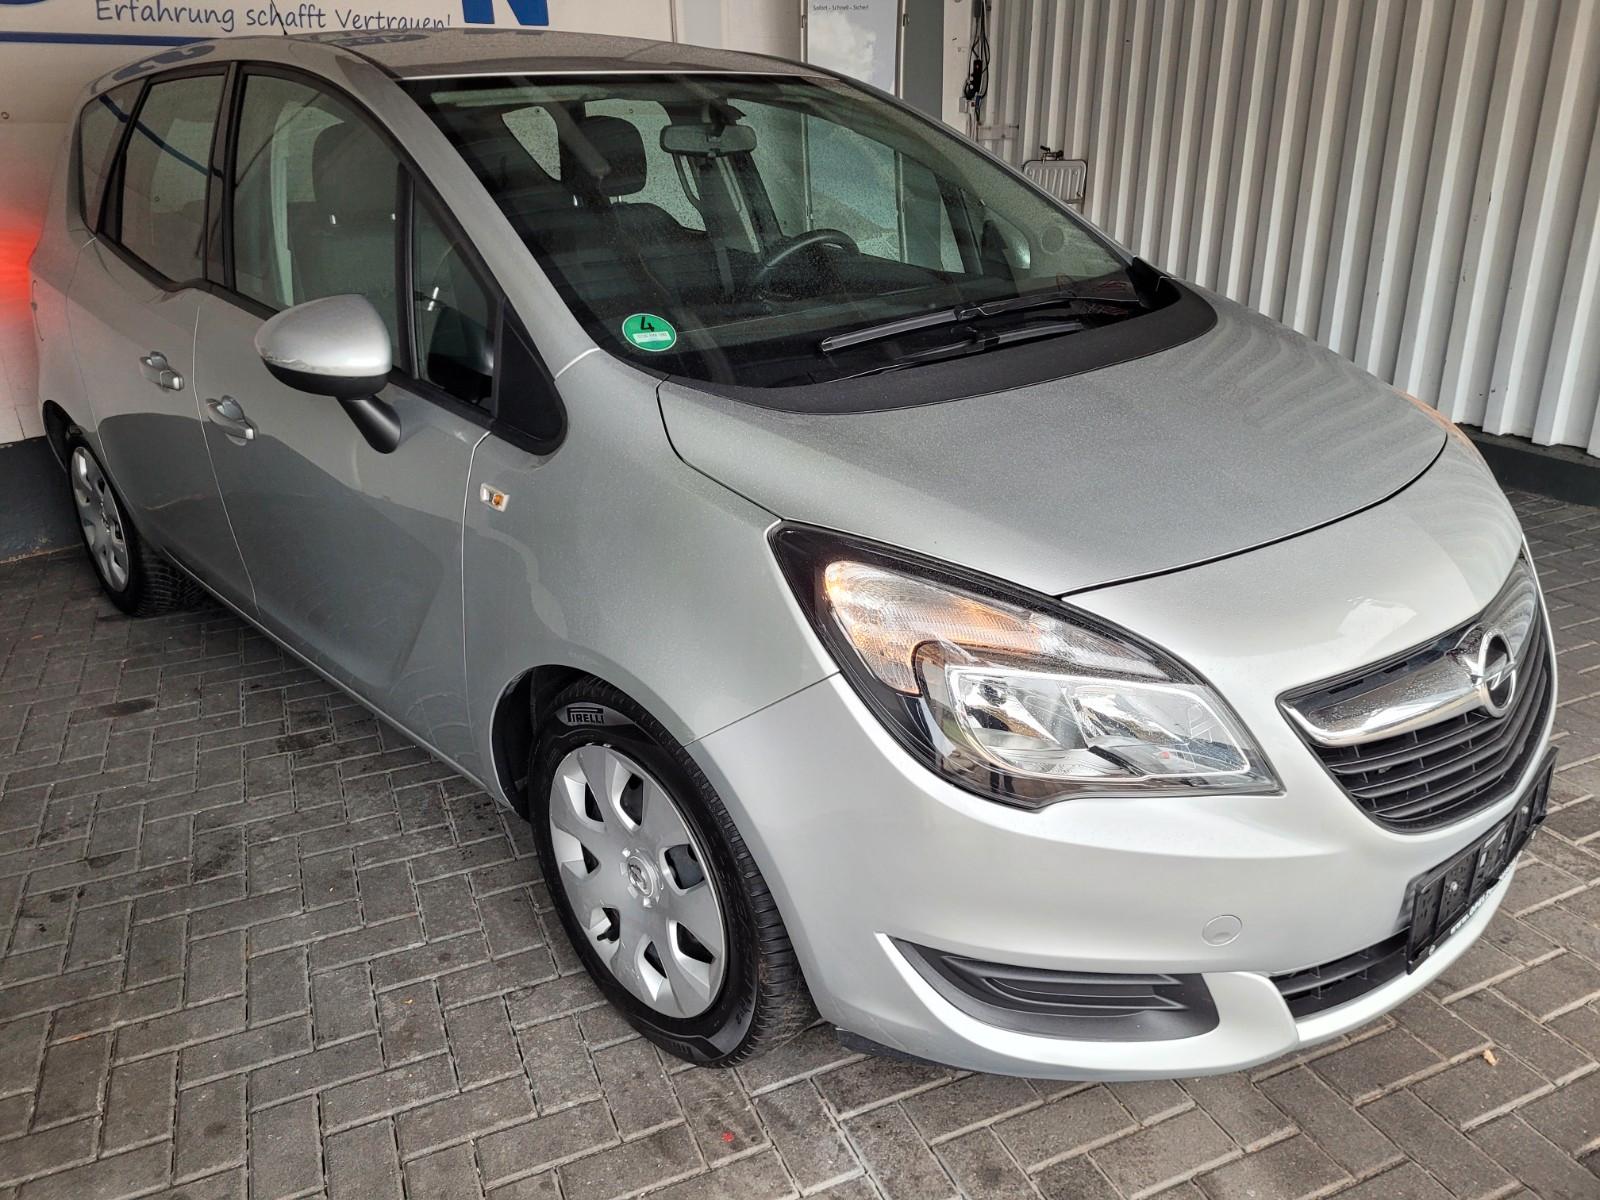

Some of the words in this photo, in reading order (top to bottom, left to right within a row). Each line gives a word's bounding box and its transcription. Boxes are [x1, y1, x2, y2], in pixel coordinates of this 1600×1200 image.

[96, 0, 235, 33] Erfahrung
[246, 3, 326, 29] schafft
[335, 9, 451, 30] Vertrauen!
[640, 316, 655, 332] 4
[567, 707, 605, 724] PIRELLI
